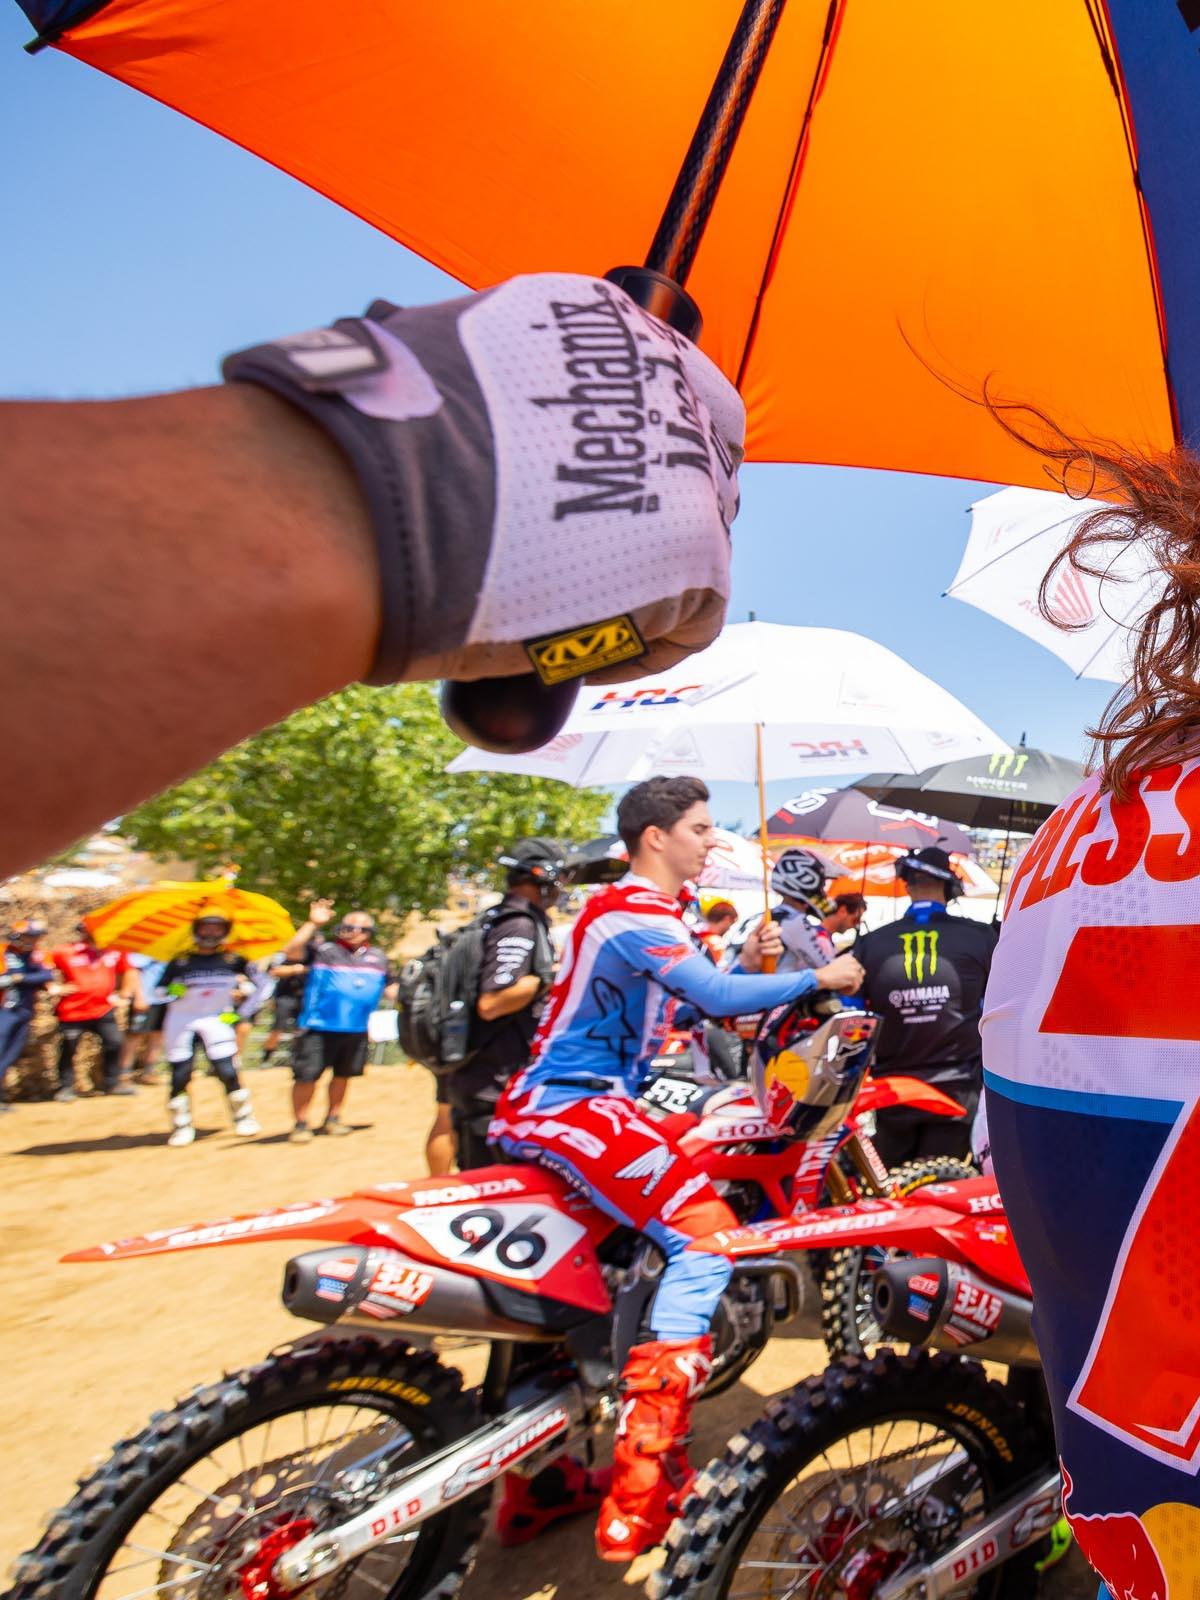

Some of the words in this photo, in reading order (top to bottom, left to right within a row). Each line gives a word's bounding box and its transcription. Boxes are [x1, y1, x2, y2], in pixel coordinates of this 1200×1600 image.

[530, 299, 646, 521] Mechanix
[902, 985, 950, 1001] YAMAHA
[411, 1178, 527, 1206] HONDA
[450, 1208, 549, 1270] 96
[768, 1211, 896, 1243] DUNLOP
[371, 1498, 422, 1537] DID
[953, 1540, 996, 1581] DID
